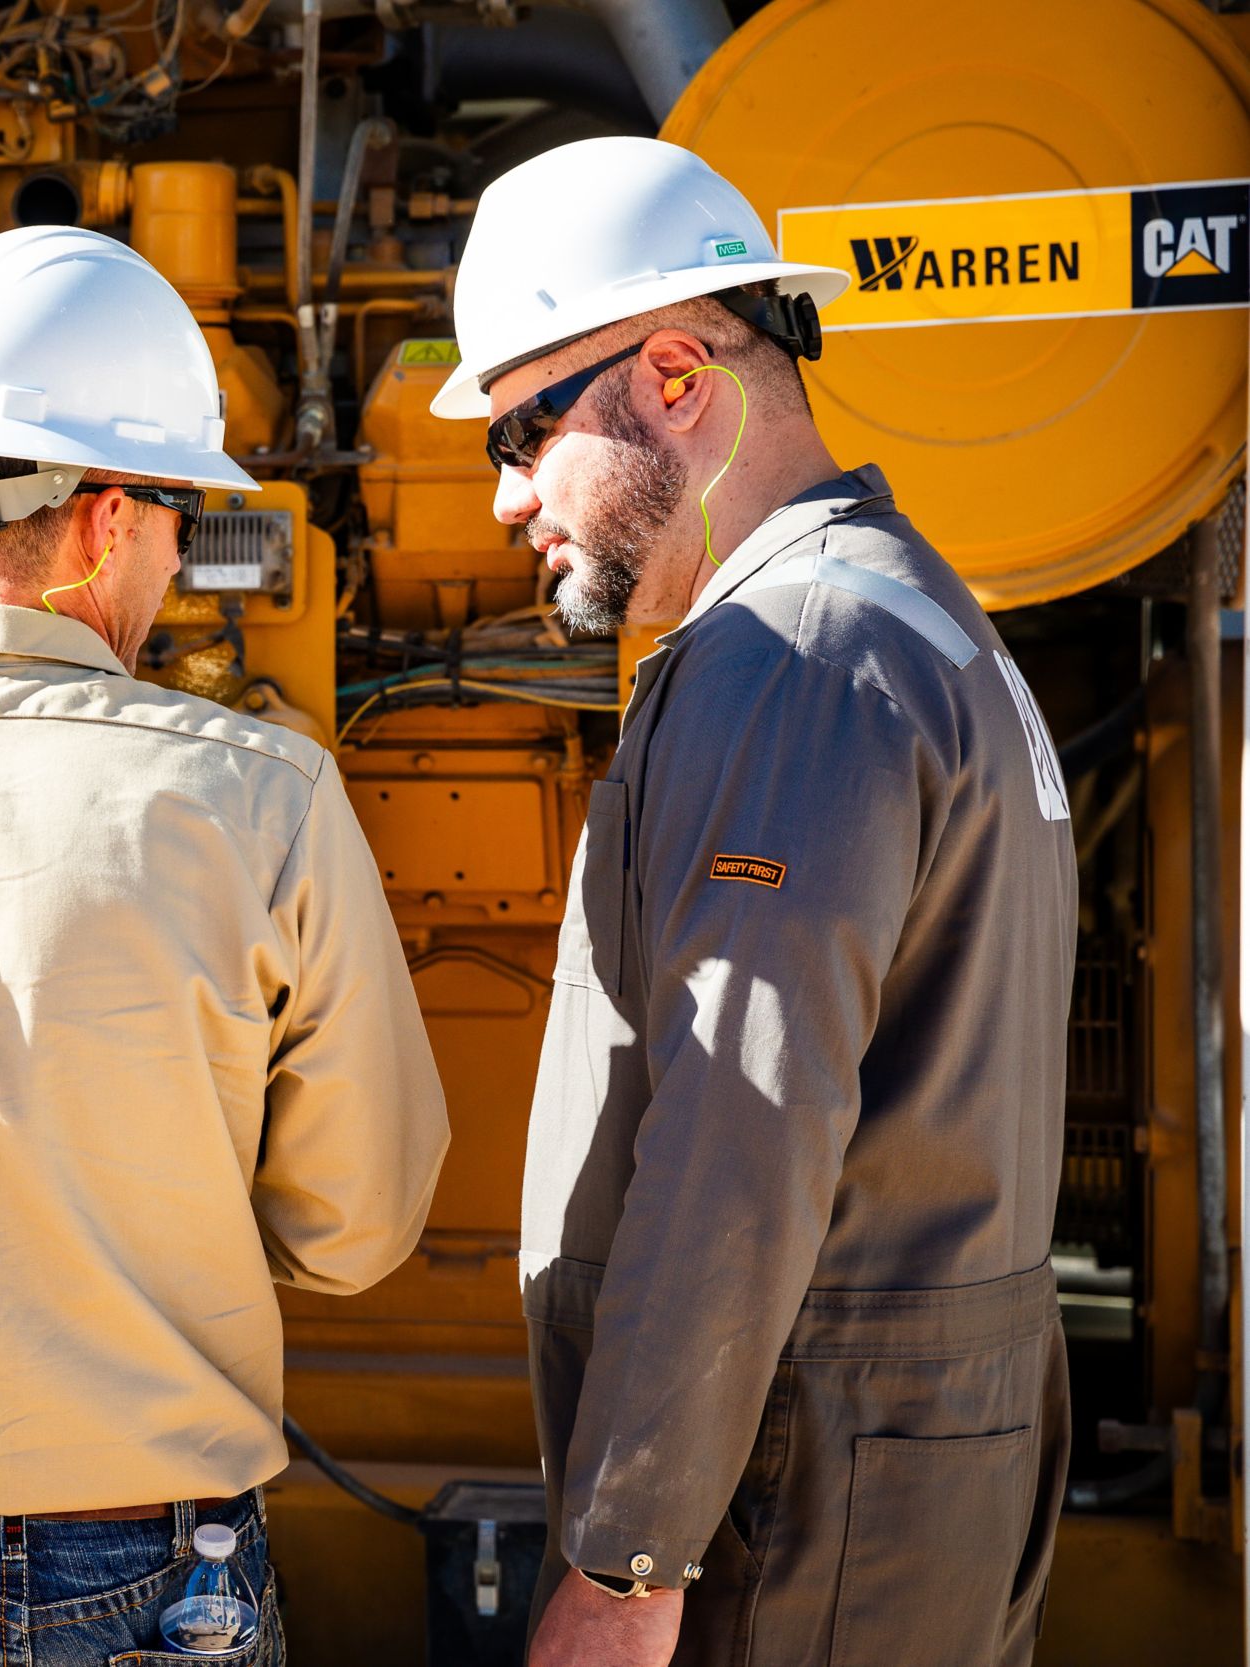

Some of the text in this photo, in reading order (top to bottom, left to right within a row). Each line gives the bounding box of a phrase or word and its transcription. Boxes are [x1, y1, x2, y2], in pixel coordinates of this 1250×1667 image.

[718, 243, 746, 256] MSA
[849, 236, 1080, 292] WARREN
[1142, 214, 1239, 278] CAT
[715, 861, 779, 881] SAFETY FIRST
